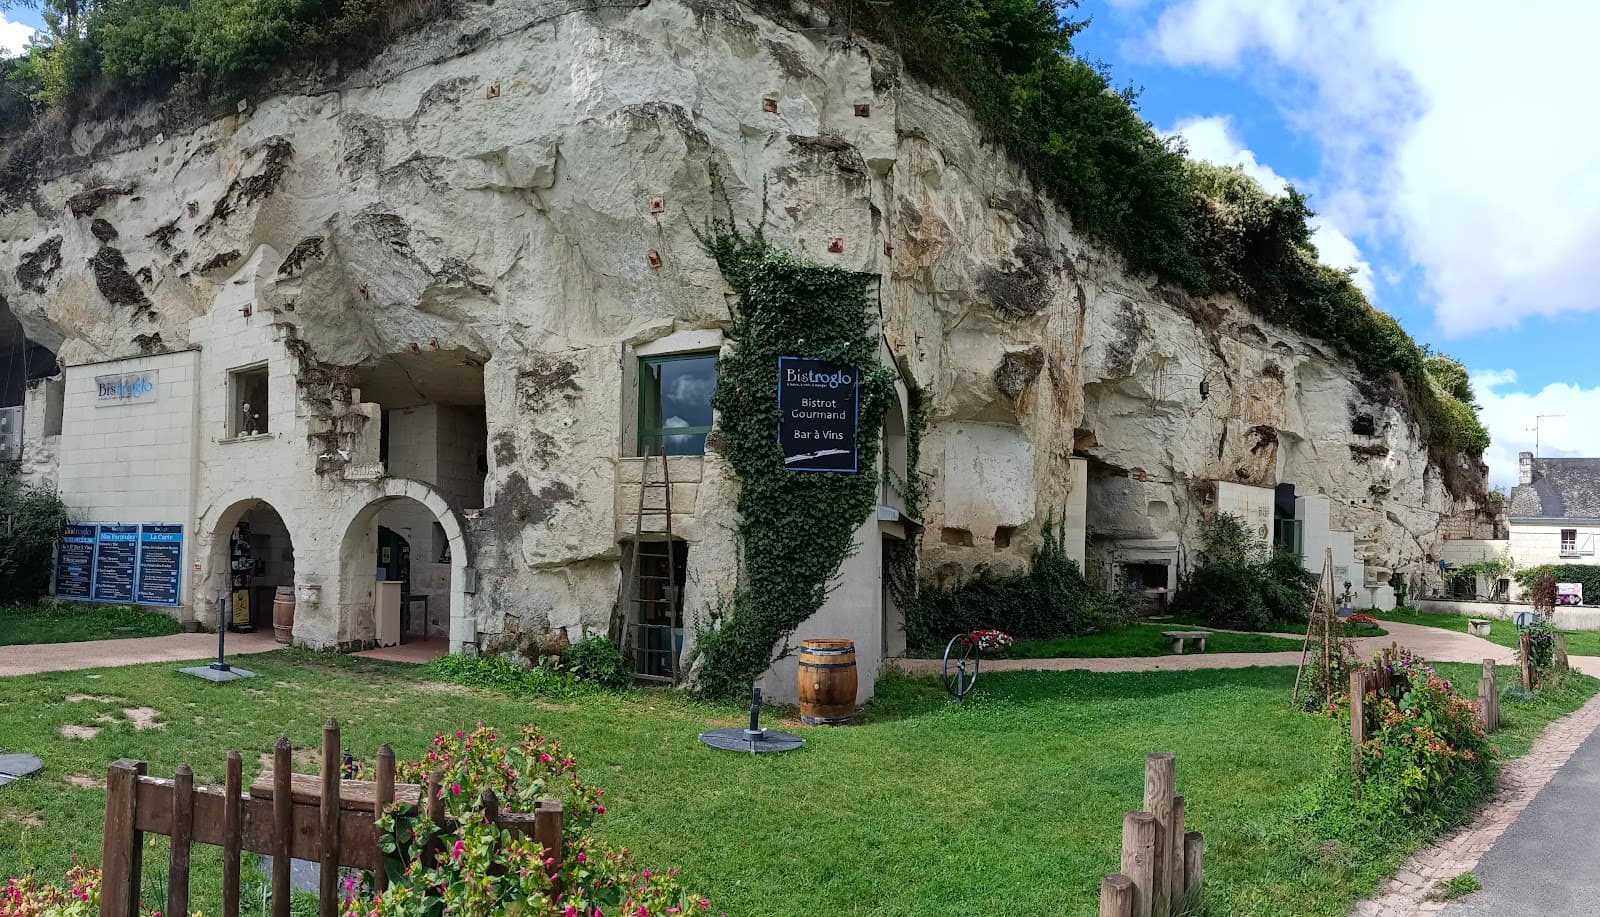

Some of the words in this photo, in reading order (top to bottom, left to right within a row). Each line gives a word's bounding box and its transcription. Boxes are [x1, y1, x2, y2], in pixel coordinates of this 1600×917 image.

[787, 369, 851, 388] Bistroglo
[801, 398, 837, 408] Bistrot
[791, 409, 846, 420] Gourmand
[794, 429, 811, 439] Bar
[814, 429, 820, 439] à
[822, 430, 844, 440] Vins
